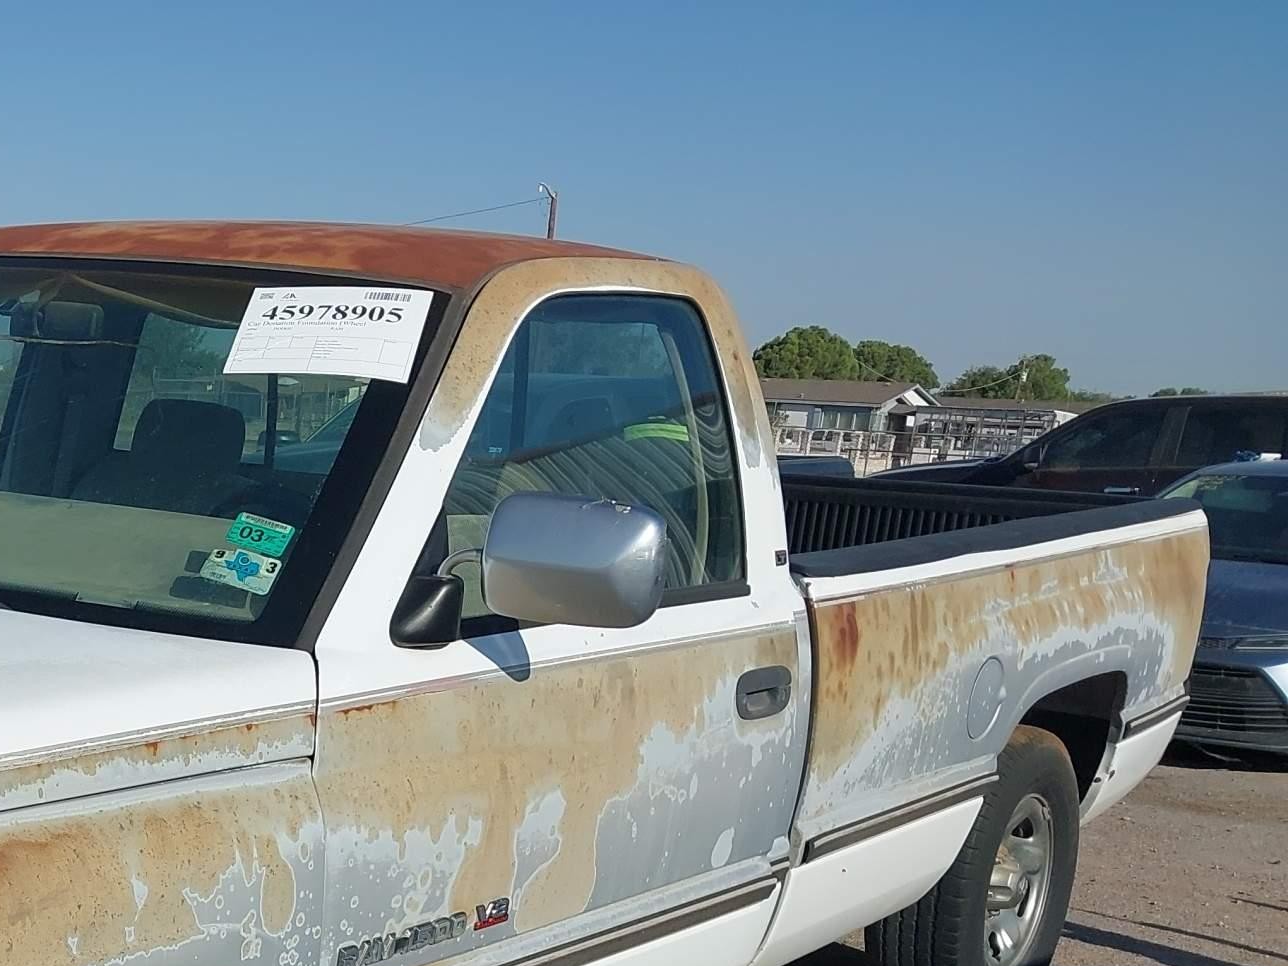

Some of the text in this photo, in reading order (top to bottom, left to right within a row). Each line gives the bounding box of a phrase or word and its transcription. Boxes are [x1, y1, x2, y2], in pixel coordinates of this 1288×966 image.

[262, 304, 404, 324] 45978905
[239, 525, 265, 543] 03
[214, 550, 226, 559] 9
[265, 562, 278, 574] 3
[403, 911, 468, 953] 1500
